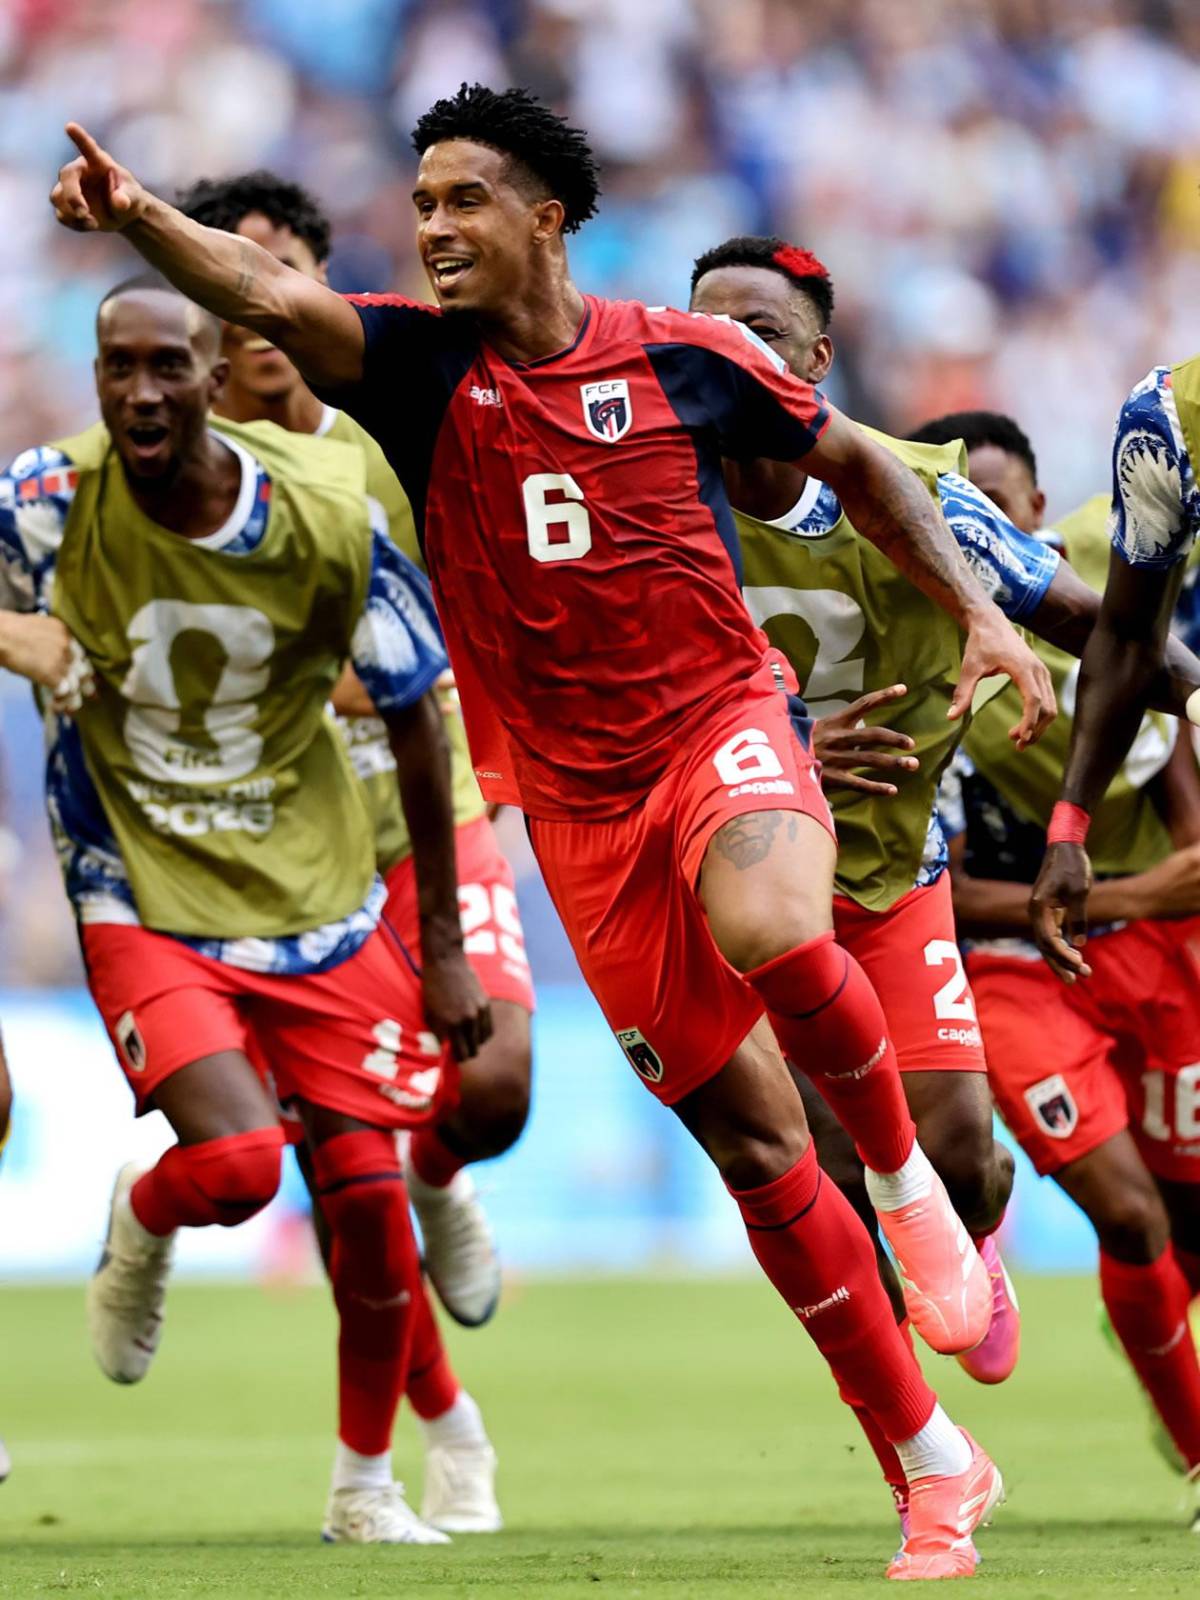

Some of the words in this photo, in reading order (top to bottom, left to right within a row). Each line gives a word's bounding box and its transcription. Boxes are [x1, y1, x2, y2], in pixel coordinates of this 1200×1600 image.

[585, 383, 623, 397] FCF
[522, 473, 592, 563] 6
[712, 728, 784, 786] 6
[924, 939, 977, 1022] 2
